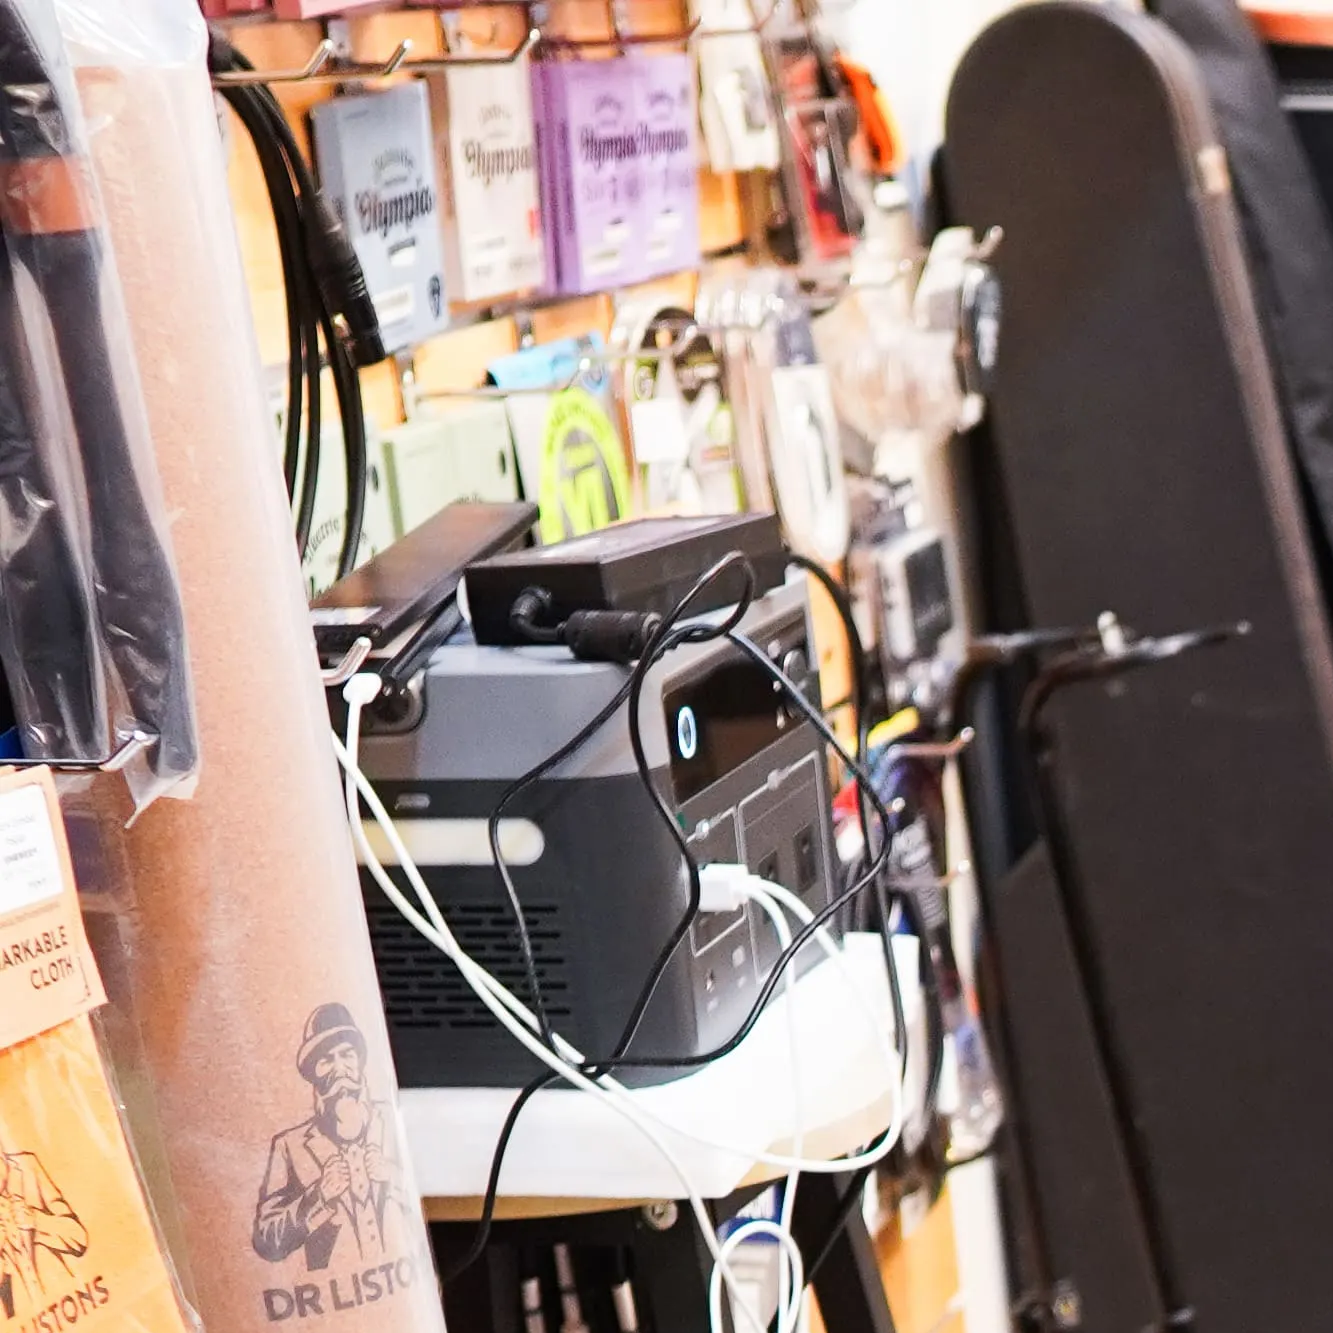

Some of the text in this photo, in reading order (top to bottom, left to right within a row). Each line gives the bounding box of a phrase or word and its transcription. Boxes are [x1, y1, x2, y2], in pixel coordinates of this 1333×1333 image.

[0, 924, 69, 970] ARKABLE
[30, 955, 75, 990] CLOTH
[263, 1283, 325, 1322] DR
